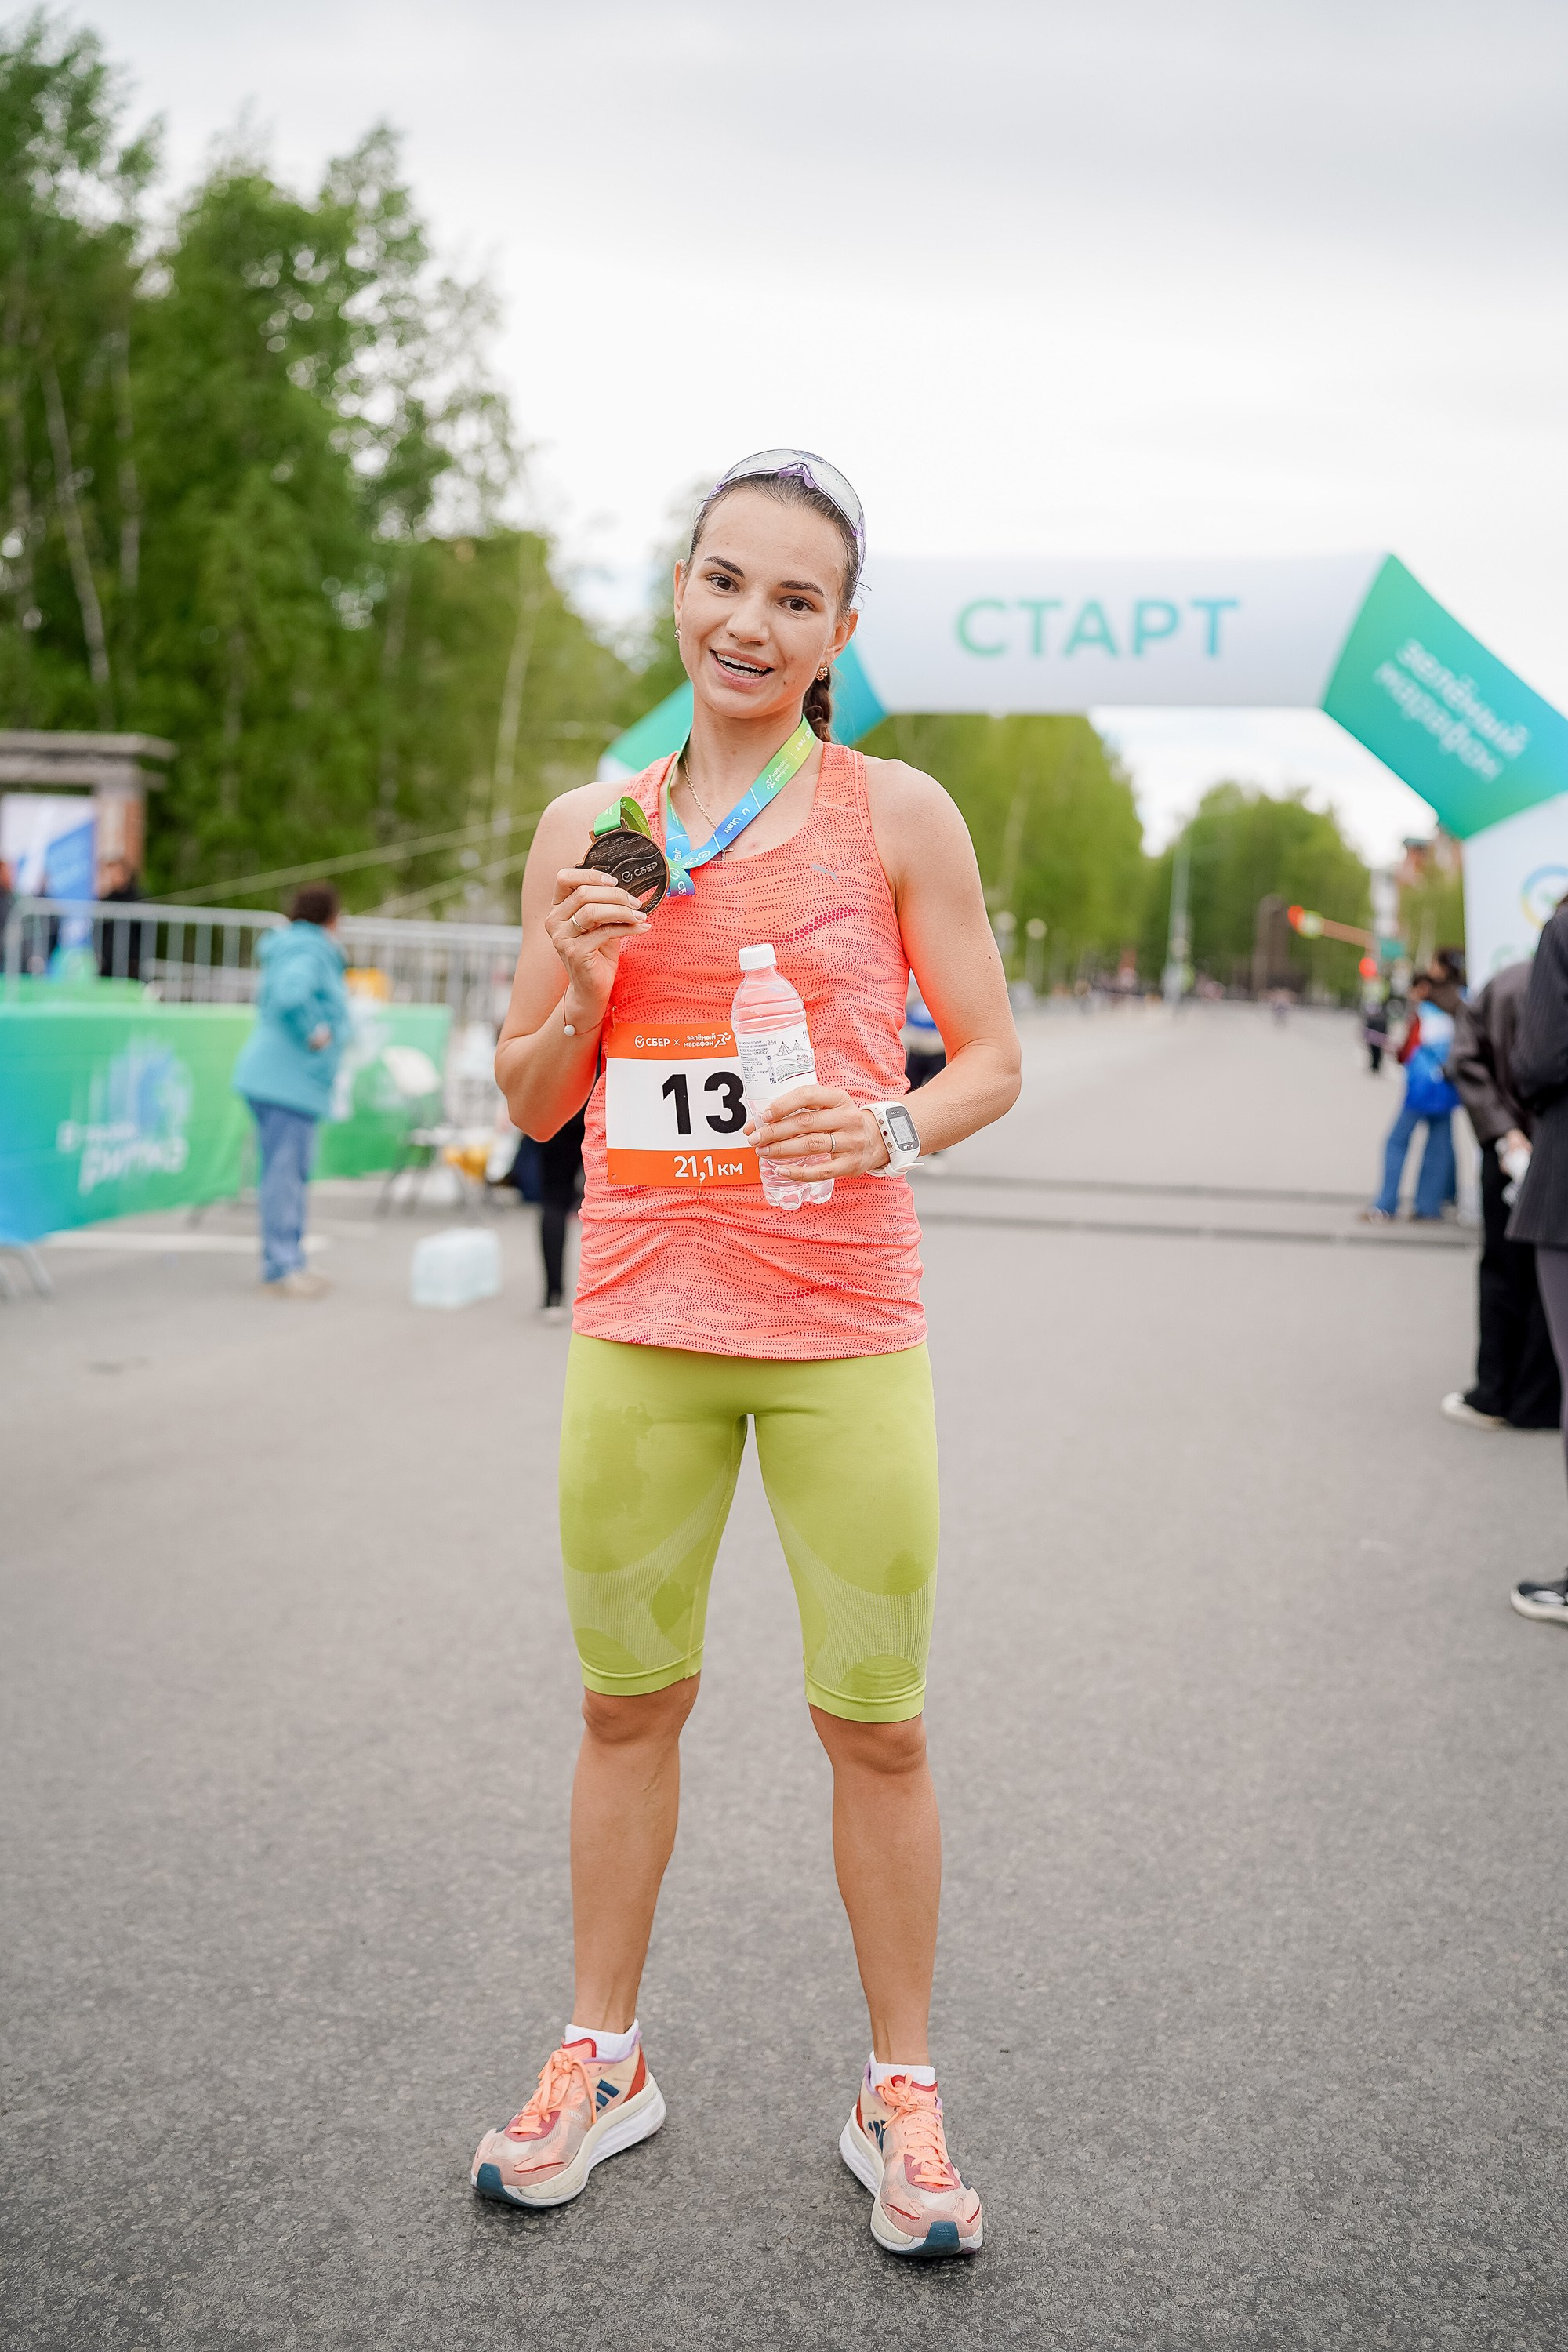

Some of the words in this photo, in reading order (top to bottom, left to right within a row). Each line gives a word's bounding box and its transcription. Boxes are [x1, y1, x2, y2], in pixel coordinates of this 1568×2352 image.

[955, 597, 1240, 657] СТАРТ
[1374, 661, 1502, 782] марафон
[724, 817, 742, 834] Utair
[633, 862, 659, 877] СБЕР
[645, 1037, 670, 1047] СБЕР
[686, 1033, 716, 1041] зелёный
[662, 1071, 747, 1135] 13
[673, 1155, 714, 1181] 21,1
